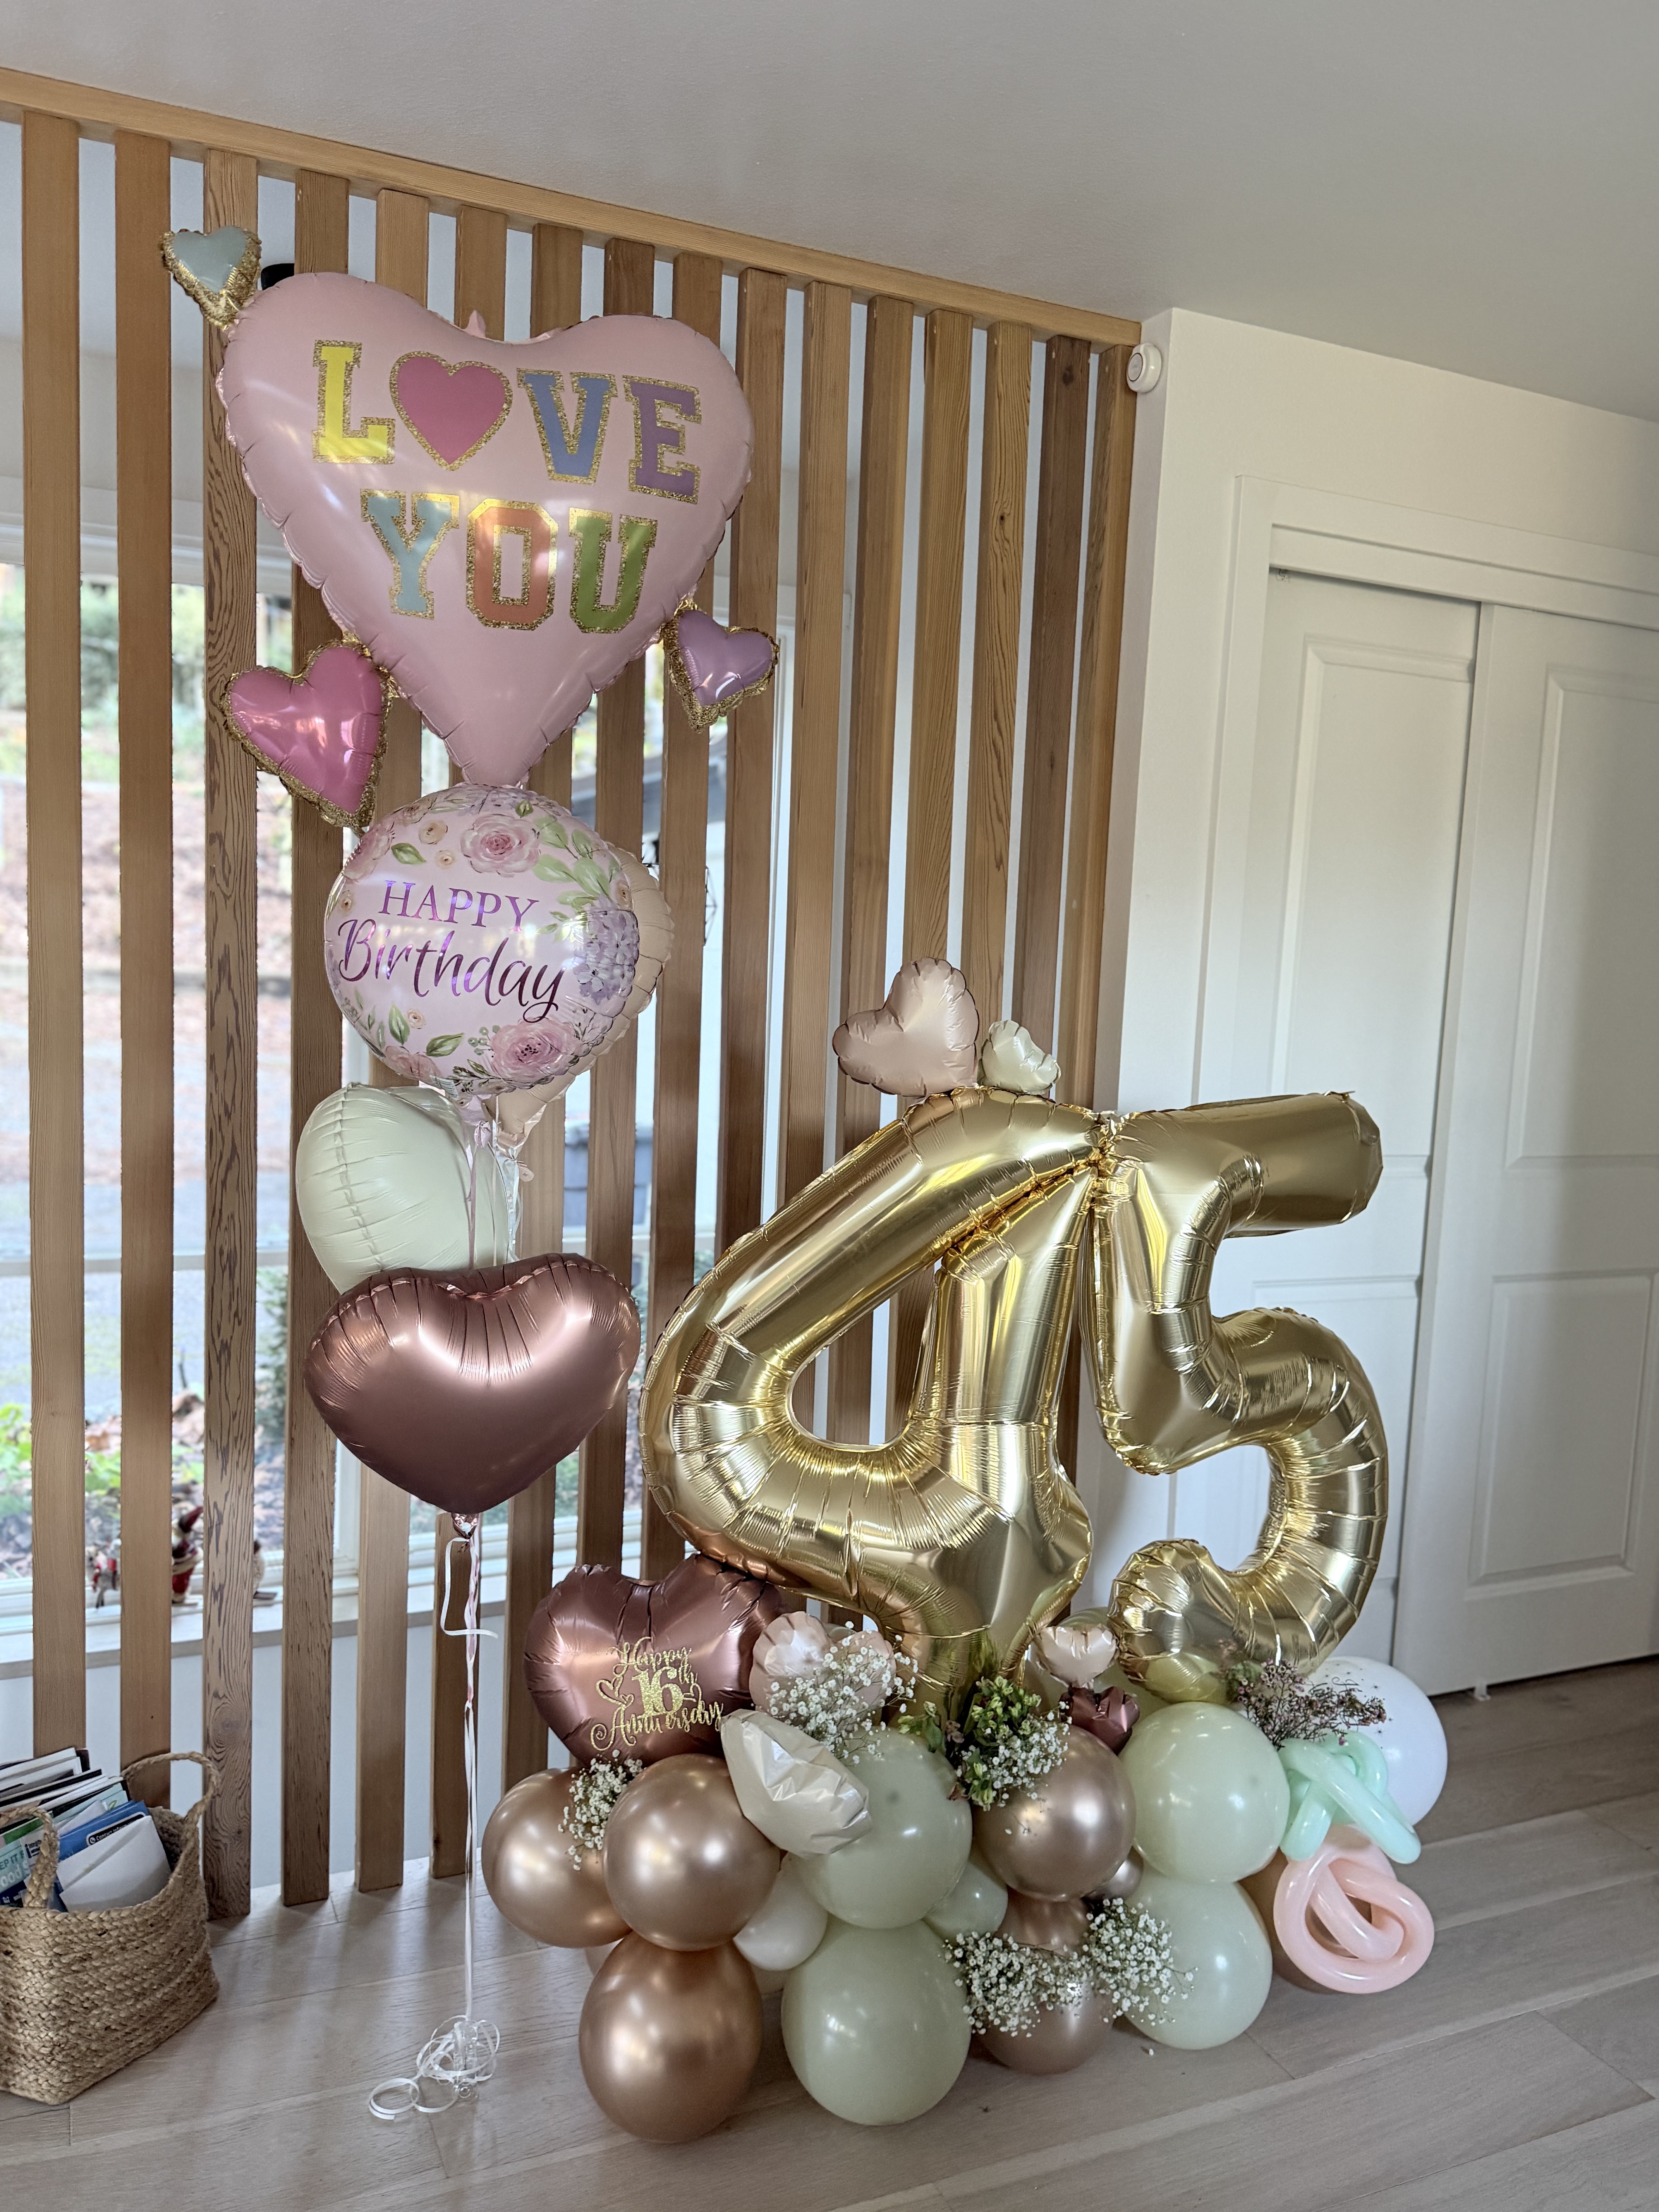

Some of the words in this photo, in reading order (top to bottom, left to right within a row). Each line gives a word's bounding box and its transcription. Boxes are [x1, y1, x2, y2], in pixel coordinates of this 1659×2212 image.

[360, 489, 658, 633] YOU
[378, 880, 539, 933] HAPPY
[338, 919, 567, 1023] Birthday
[606, 1636, 692, 1677] Happy
